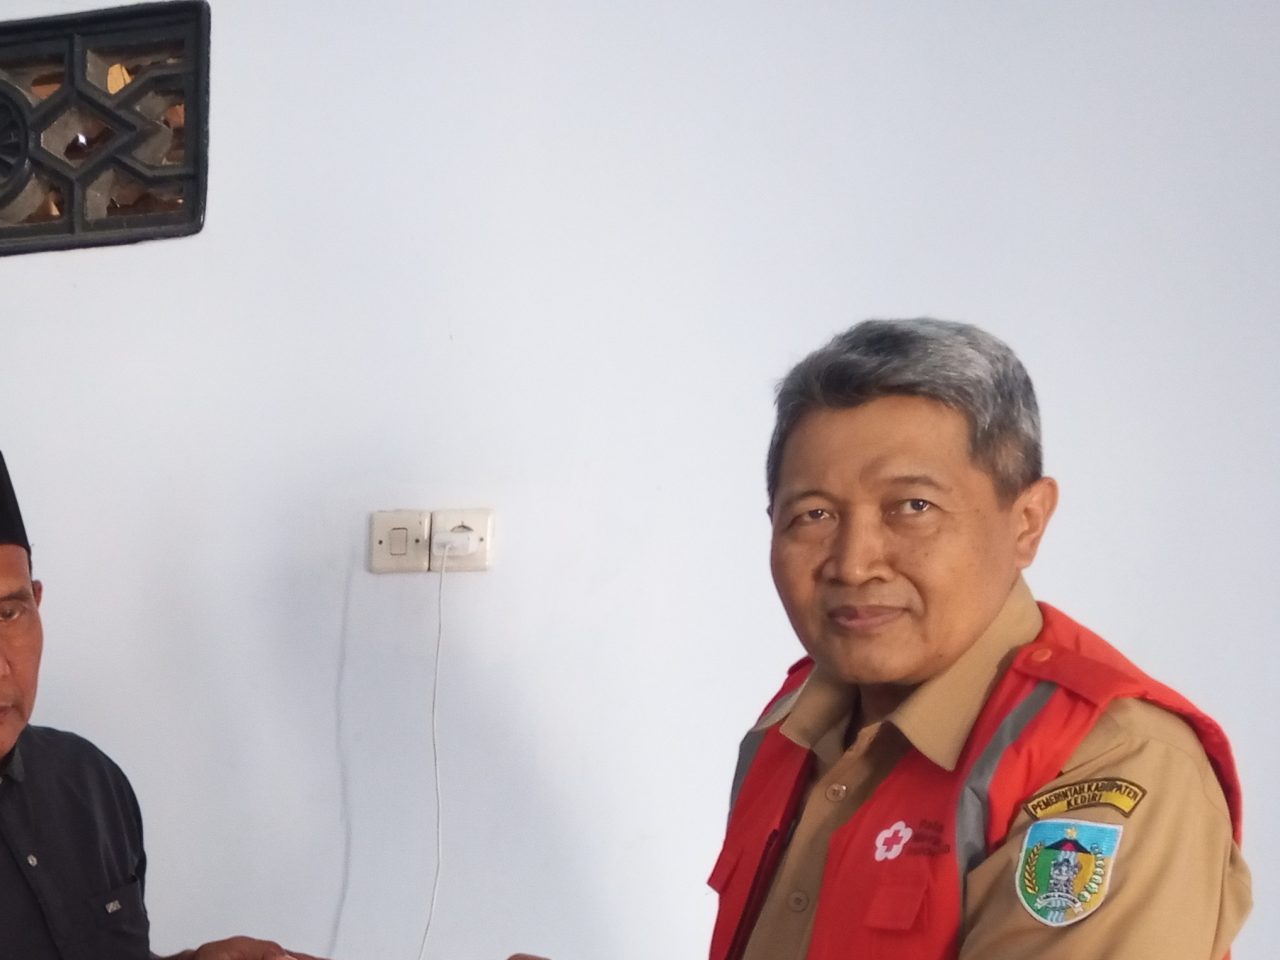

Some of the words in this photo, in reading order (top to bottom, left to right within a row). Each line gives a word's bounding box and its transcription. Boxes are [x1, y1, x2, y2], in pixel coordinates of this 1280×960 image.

[1031, 784, 1085, 814] PEMERINTAH
[1087, 781, 1140, 801] KAATEN
[1066, 793, 1102, 810] KEDIRI
